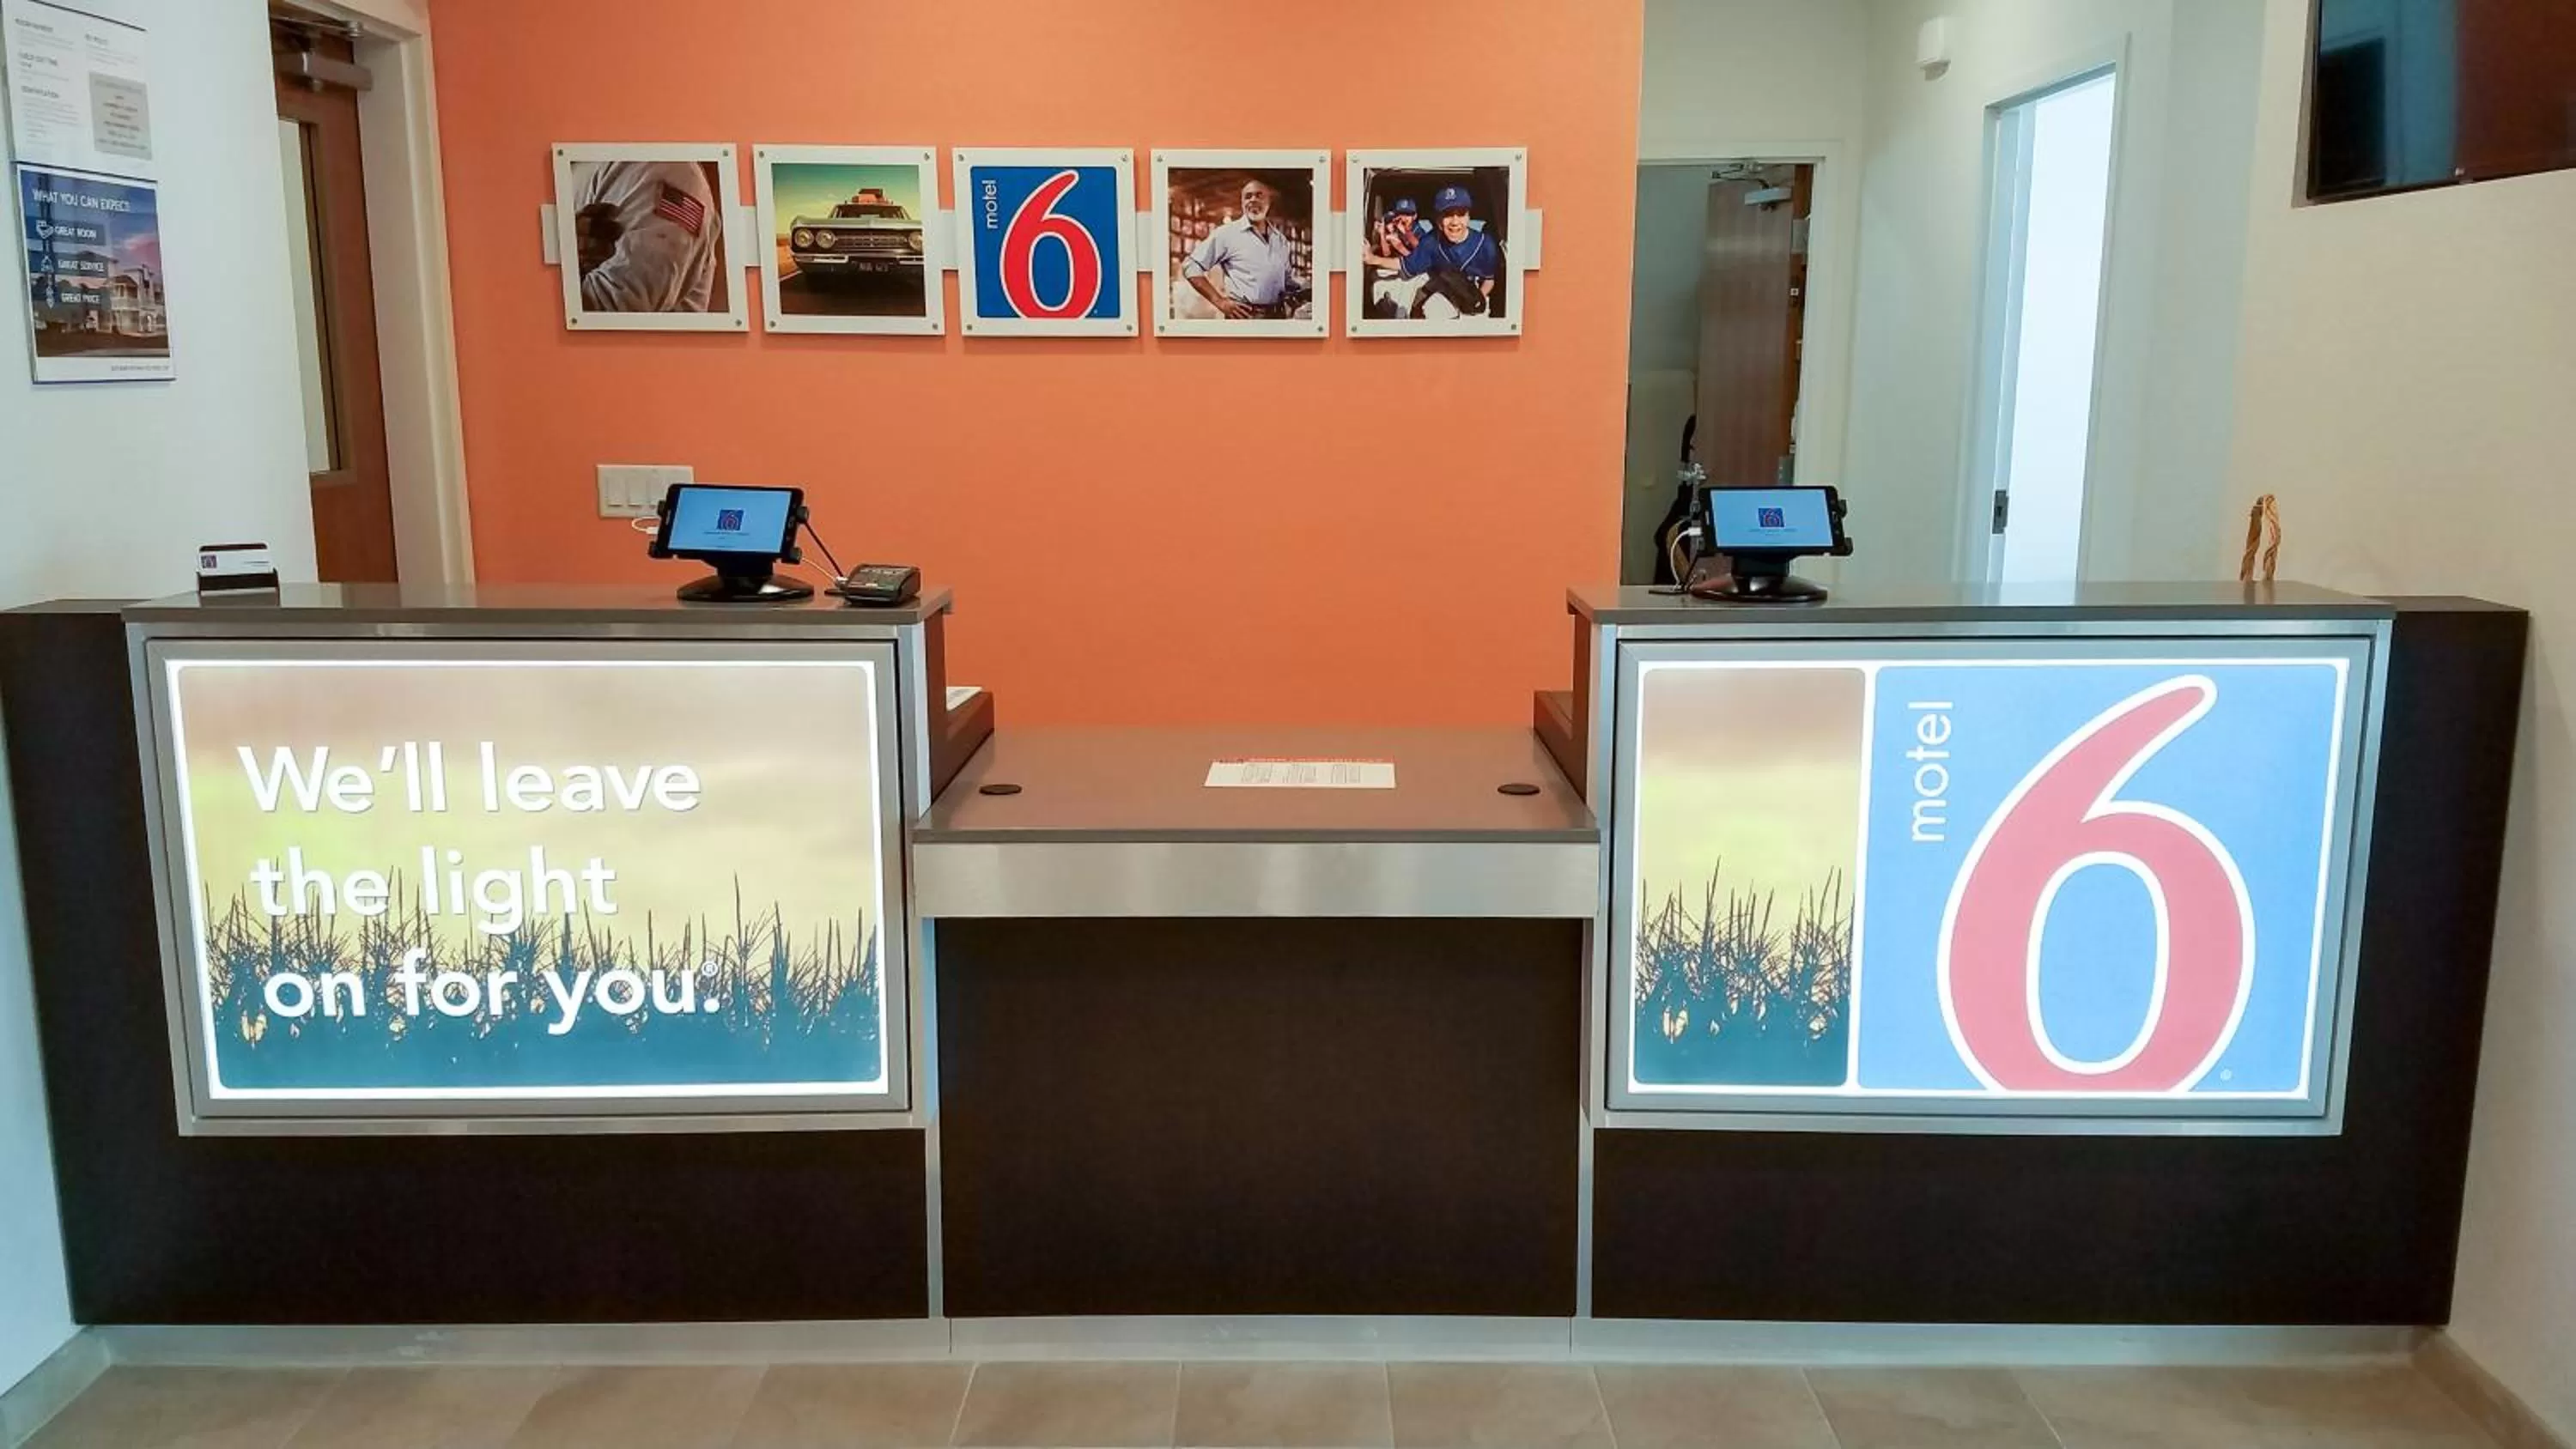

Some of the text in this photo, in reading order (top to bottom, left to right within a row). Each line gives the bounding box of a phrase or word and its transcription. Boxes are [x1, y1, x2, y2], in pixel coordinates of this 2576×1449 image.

[60, 192, 78, 207] YOU
[80, 195, 98, 209] CAN
[982, 179, 999, 229] motel
[999, 169, 1103, 318] 6
[237, 741, 702, 813] We'll leave
[1906, 700, 1953, 842] motel
[250, 846, 618, 935] the light
[1936, 675, 2256, 1092] 6
[264, 969, 366, 1017] on
[389, 947, 518, 1016] for
